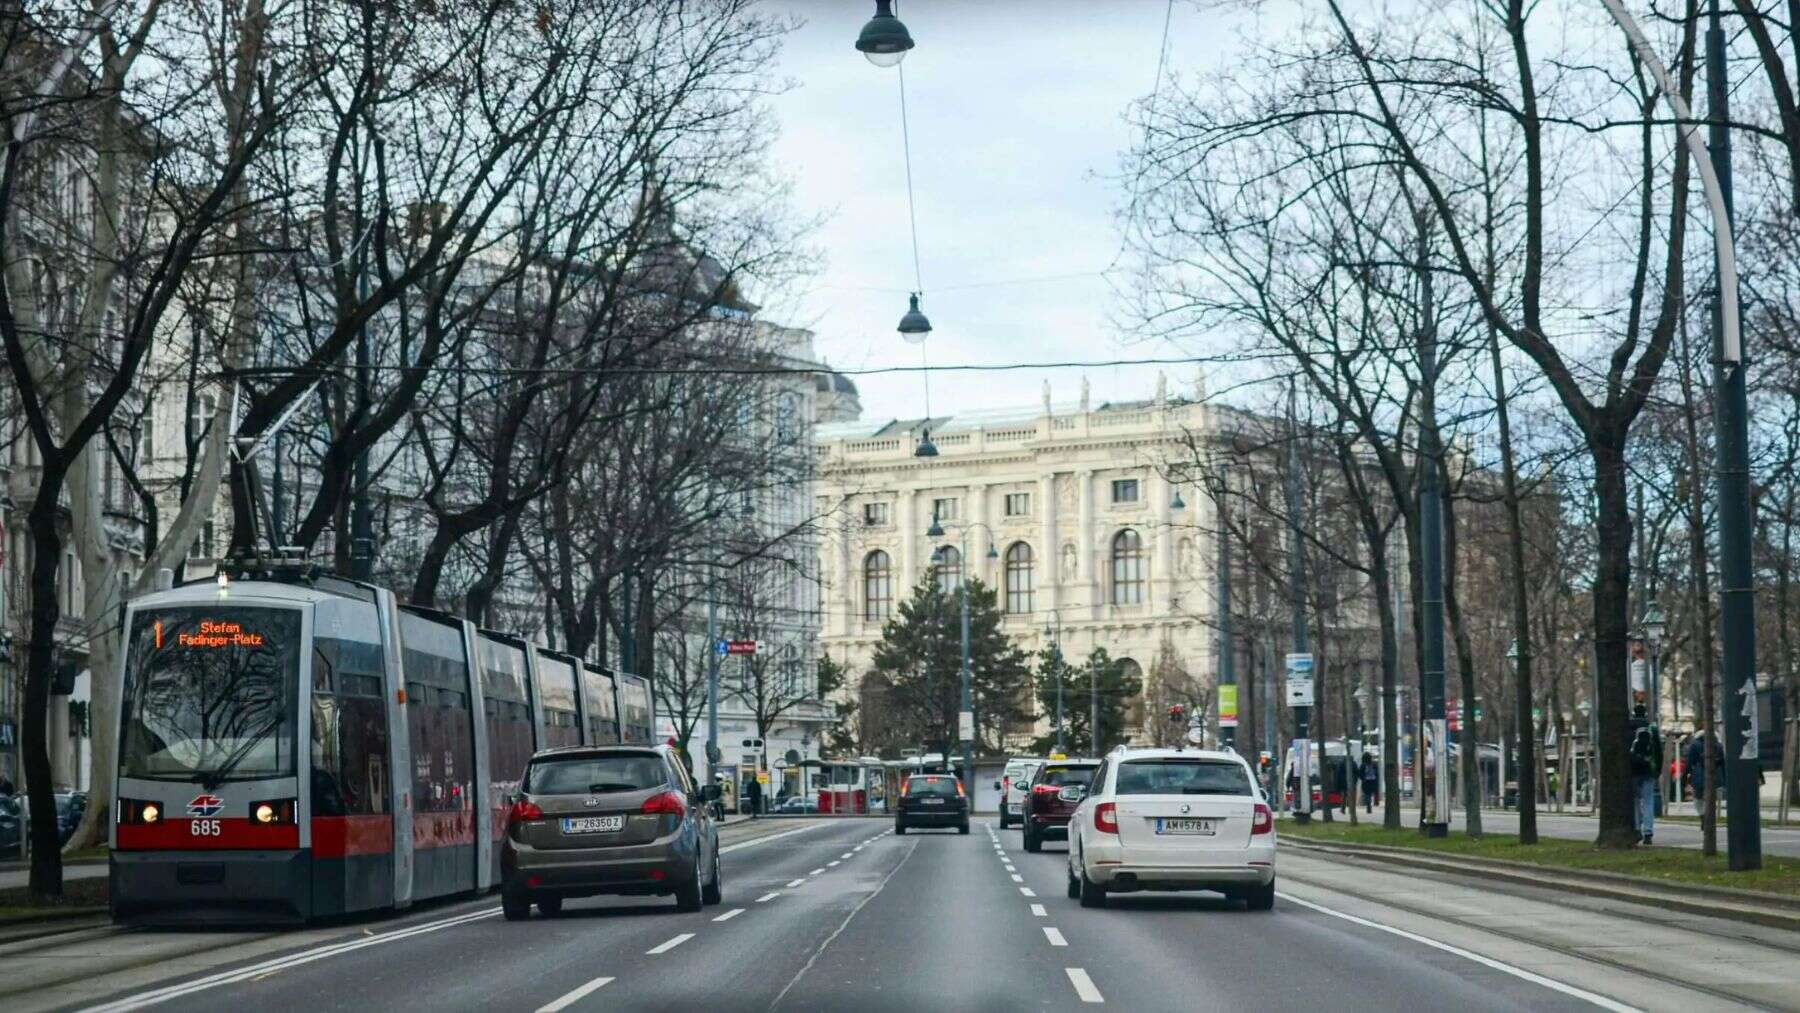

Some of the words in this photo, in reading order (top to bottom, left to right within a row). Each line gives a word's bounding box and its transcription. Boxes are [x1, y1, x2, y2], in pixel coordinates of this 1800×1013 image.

[201, 622, 240, 633] Stefan
[154, 621, 162, 648] 1
[179, 634, 262, 647] Fadinger-Platz
[191, 820, 221, 836] 685
[1166, 820, 1178, 830] AM
